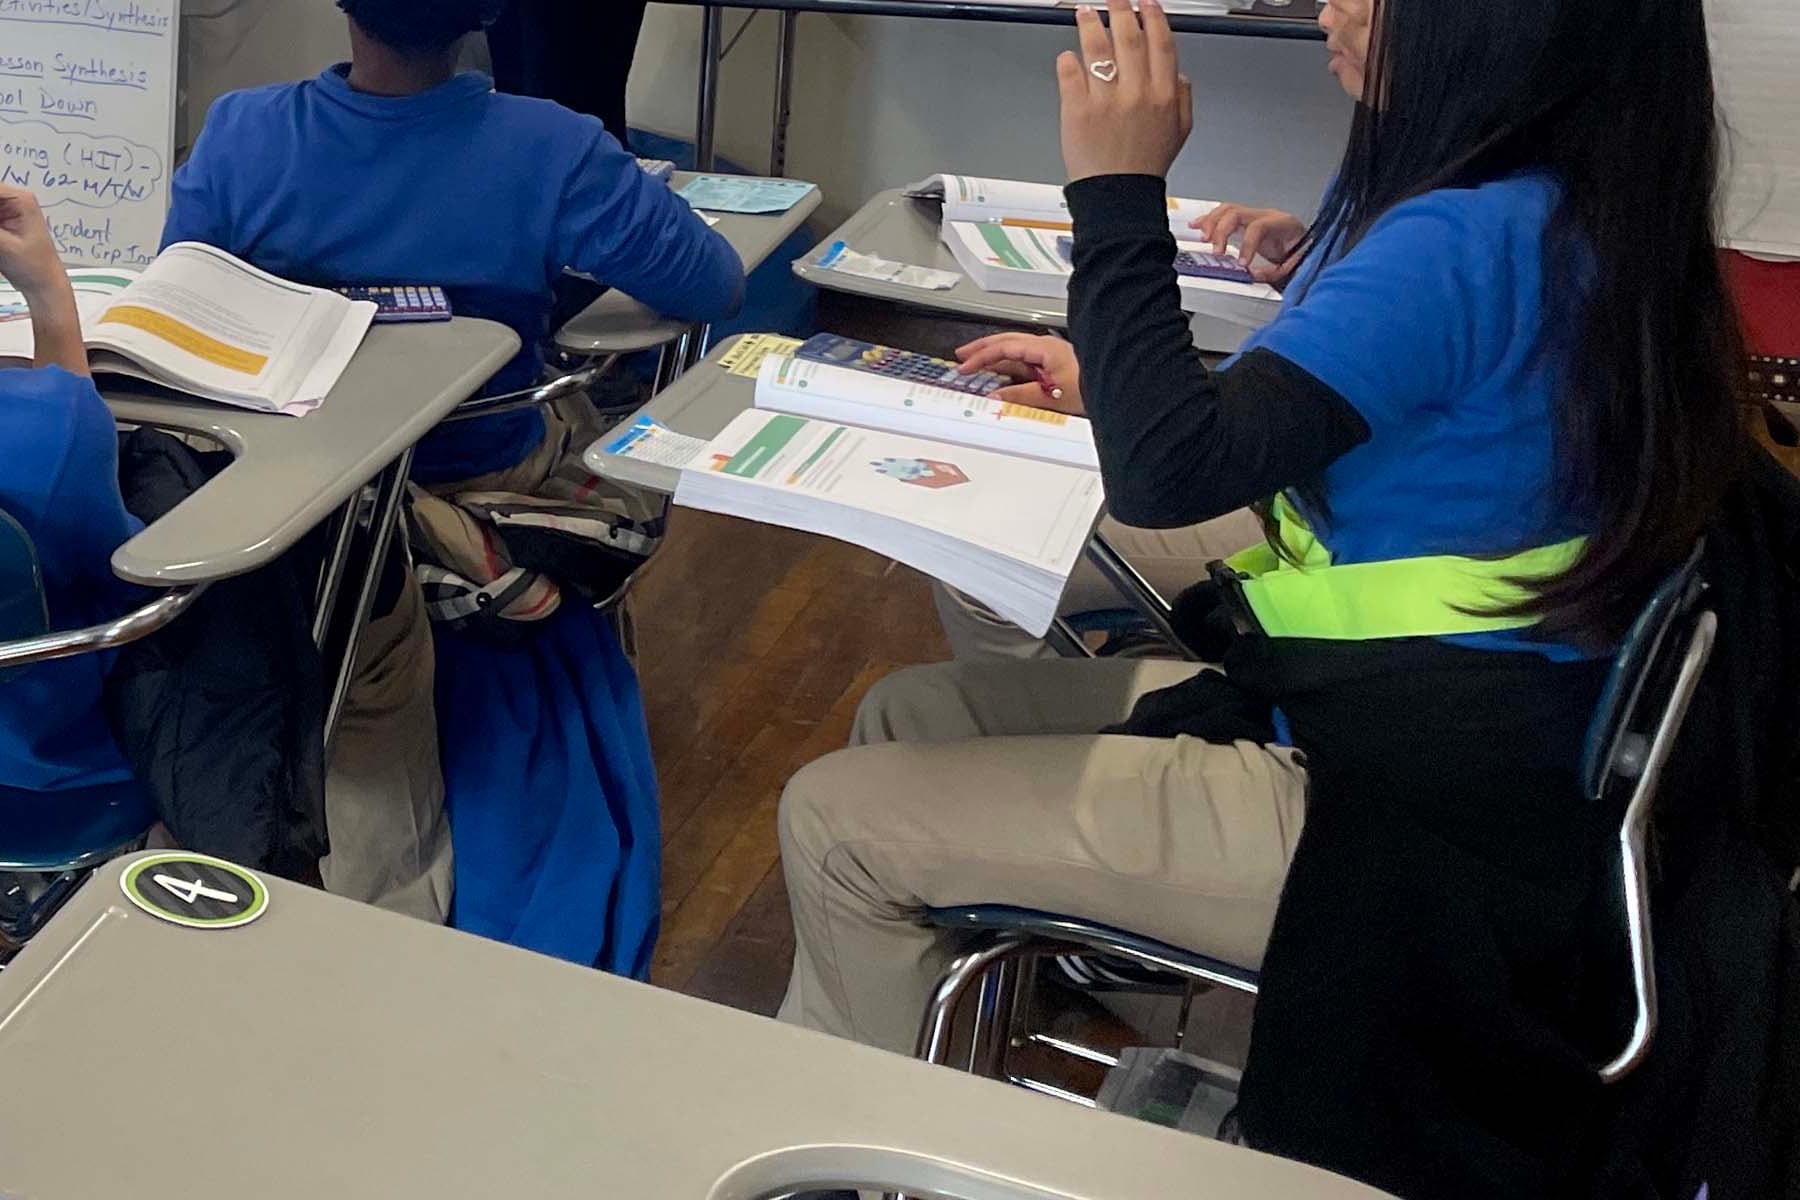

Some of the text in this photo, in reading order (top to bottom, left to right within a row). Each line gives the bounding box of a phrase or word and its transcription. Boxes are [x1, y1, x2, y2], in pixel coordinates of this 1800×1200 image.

[53, 53, 148, 85] Synthesis
[40, 87, 98, 115] Down
[42, 171, 78, 188] 62
[46, 216, 112, 242] endent
[153, 873, 238, 904] 4
